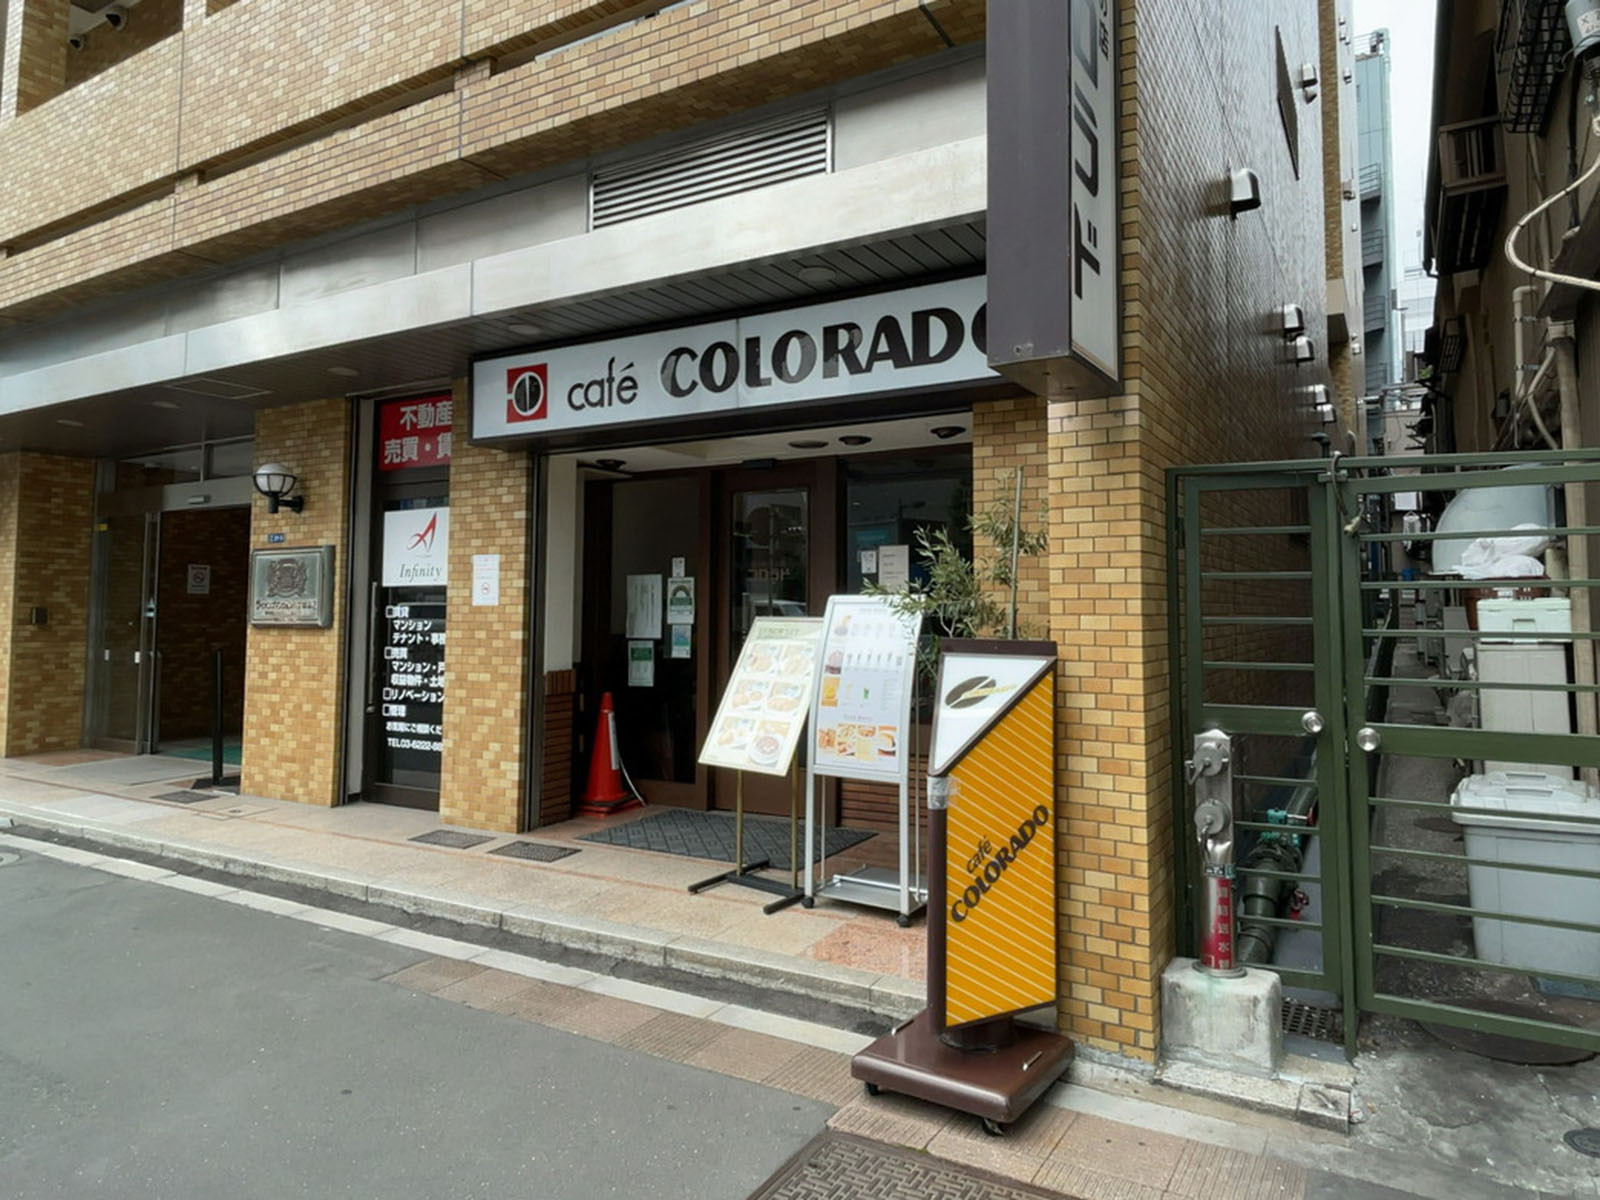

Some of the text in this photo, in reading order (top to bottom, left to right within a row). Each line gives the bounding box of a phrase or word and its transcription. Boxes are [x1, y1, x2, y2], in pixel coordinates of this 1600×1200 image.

[567, 356, 639, 412] café
[400, 401, 452, 431] 不動産
[400, 562, 442, 583] Infinity
[393, 620, 432, 631] マンション
[391, 689, 446, 702] リノベーション
[951, 805, 1049, 923] COLORADO
[966, 834, 993, 873] café
